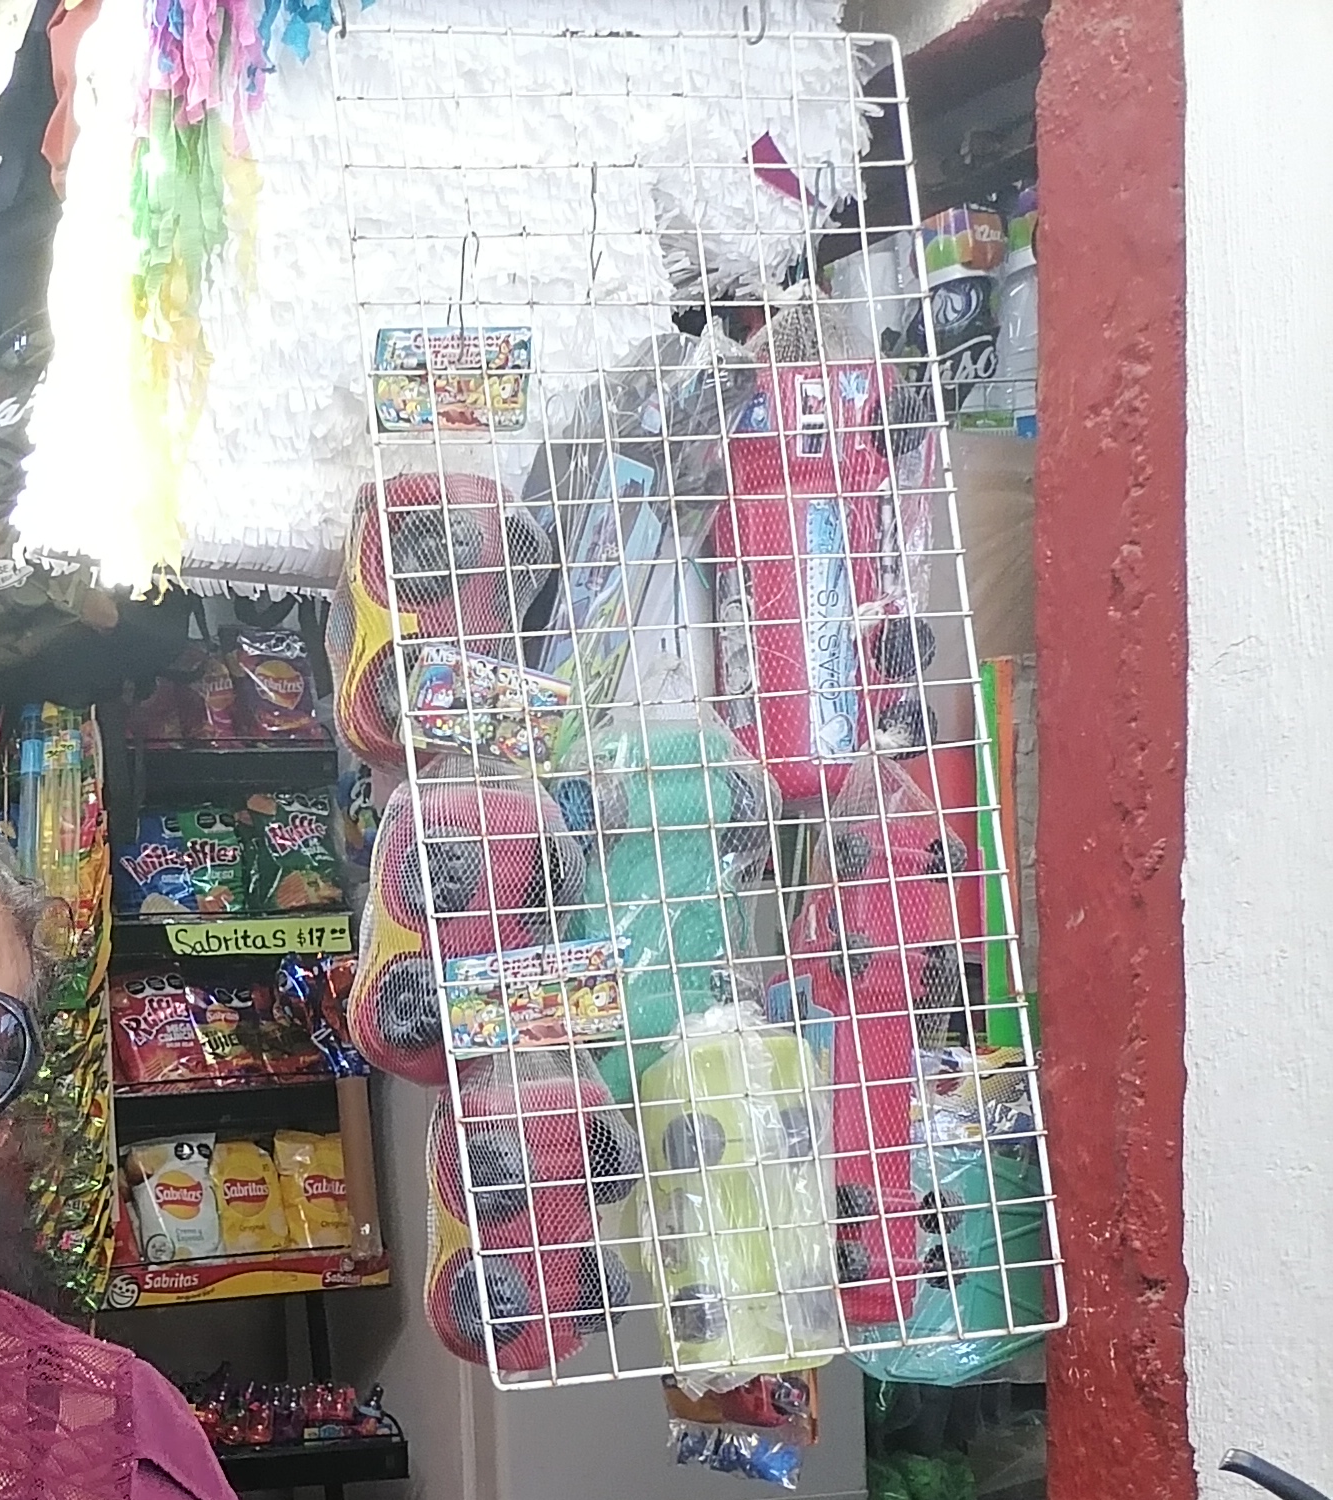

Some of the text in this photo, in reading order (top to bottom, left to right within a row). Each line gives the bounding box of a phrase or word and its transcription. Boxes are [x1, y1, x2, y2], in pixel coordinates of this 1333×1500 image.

[175, 928, 286, 956] Sabritas
[154, 1186, 204, 1204] Sabritas
[223, 1181, 270, 1198] Sabritas
[144, 1272, 200, 1289] Sabritas
